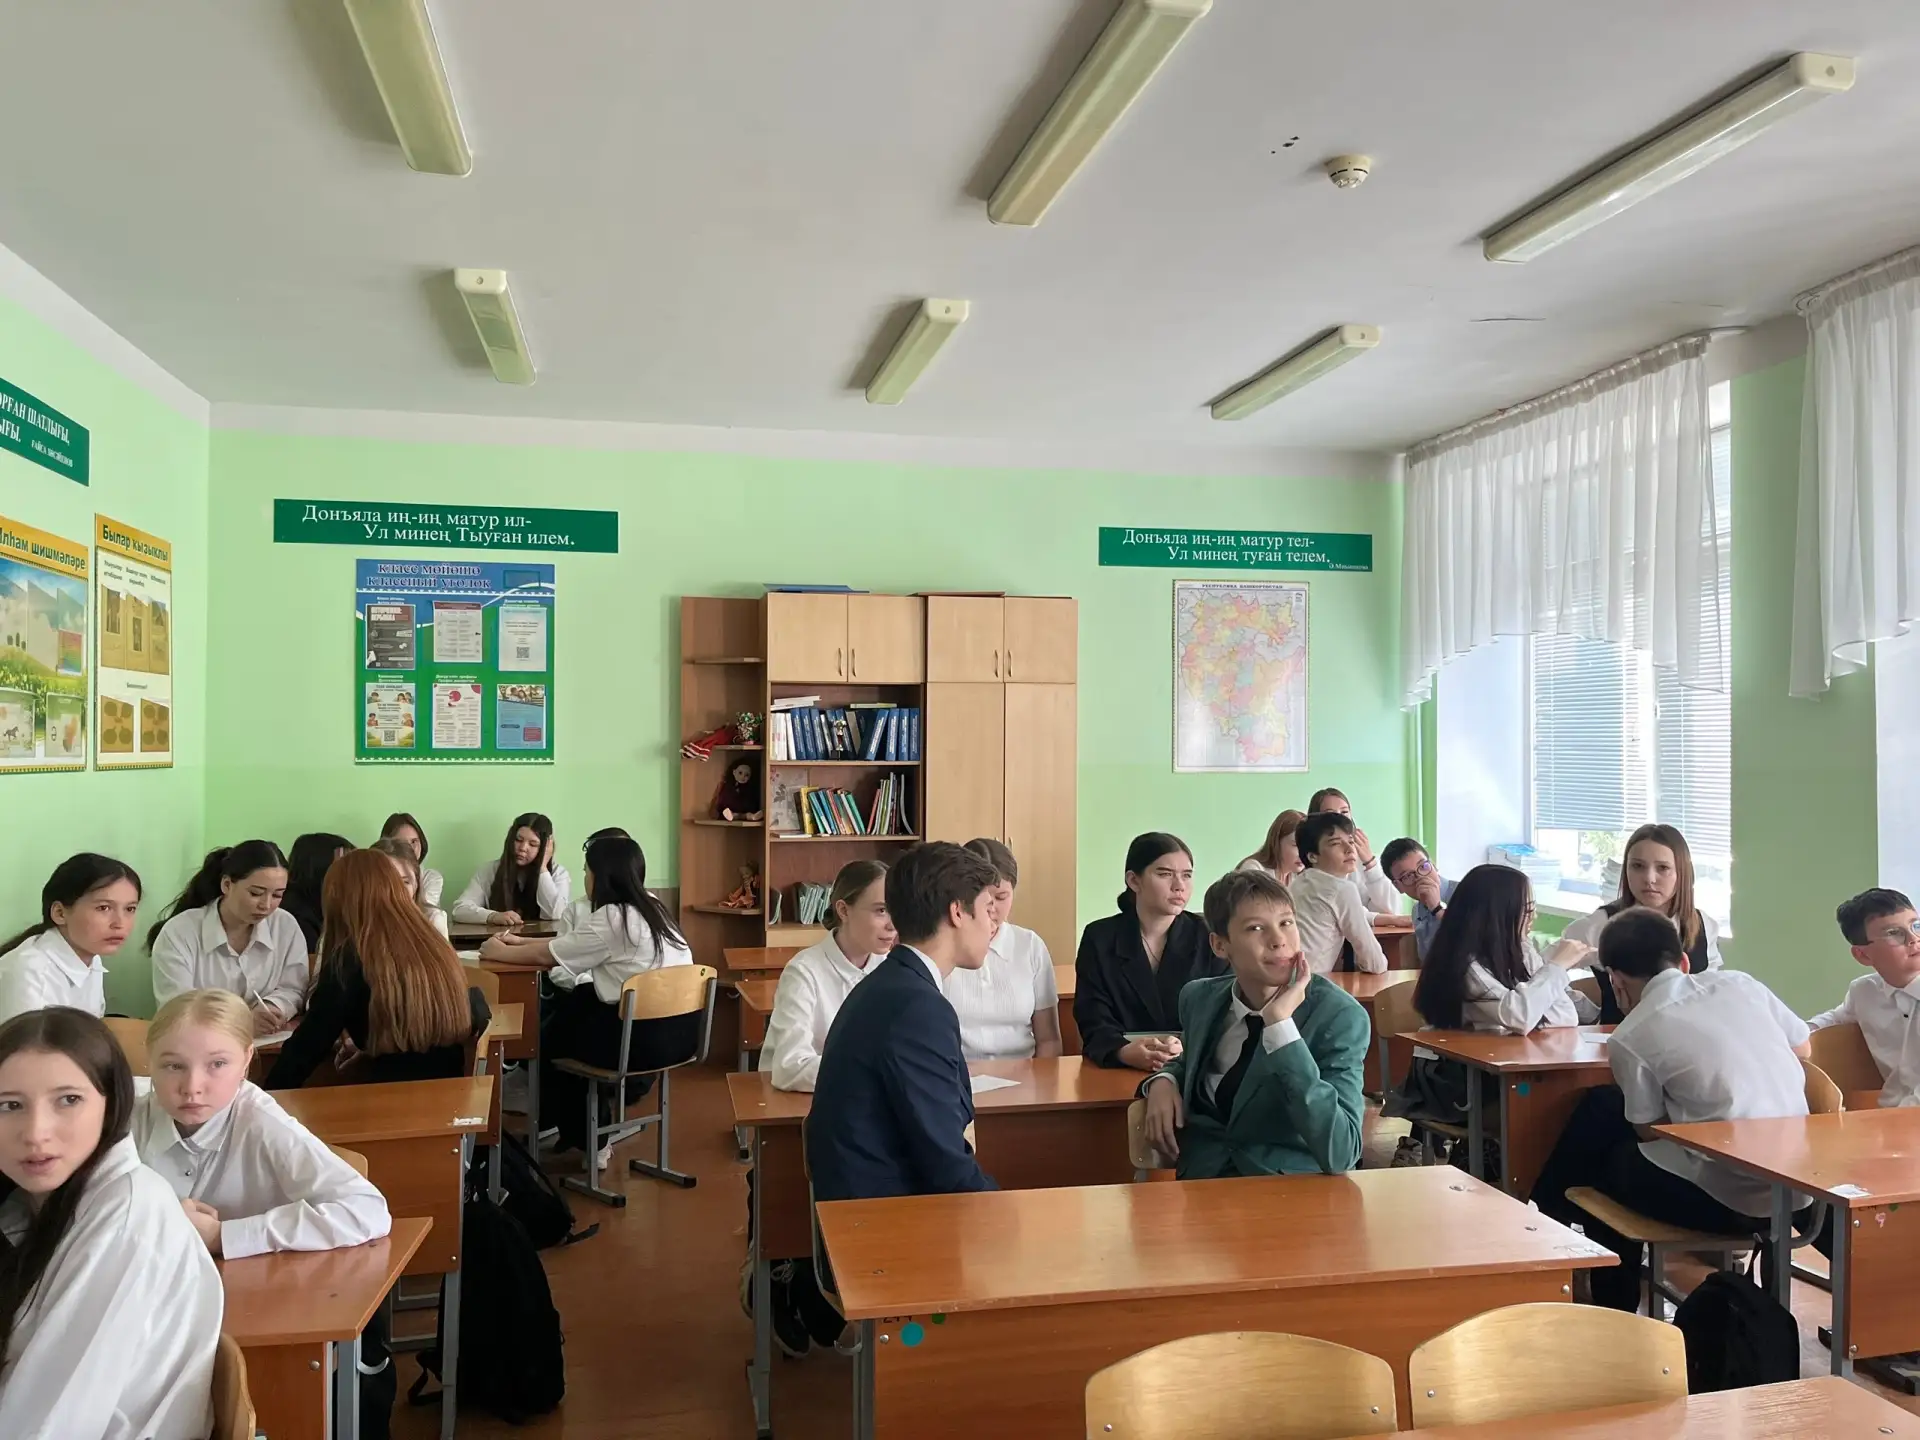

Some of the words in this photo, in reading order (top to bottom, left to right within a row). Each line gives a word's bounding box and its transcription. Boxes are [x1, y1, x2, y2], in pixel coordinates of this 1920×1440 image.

[302, 505, 382, 523] Донъяла
[388, 511, 442, 527] иң-иң
[447, 513, 500, 530] матур
[504, 516, 532, 528] ил-
[103, 524, 131, 551] Былар
[363, 523, 389, 539] Ул
[394, 528, 452, 543] минең
[456, 527, 522, 546] Тыуған
[527, 532, 575, 546] илем.
[1122, 529, 1188, 545] Донъяла
[1192, 534, 1237, 547] иң-иң
[1240, 536, 1283, 550] матур
[1287, 537, 1315, 548] тел-
[1168, 546, 1188, 560] Ул
[1192, 550, 1239, 563] минең
[1242, 551, 1282, 565] туған
[1286, 552, 1330, 563] телем.
[441, 578, 492, 590] уголок
